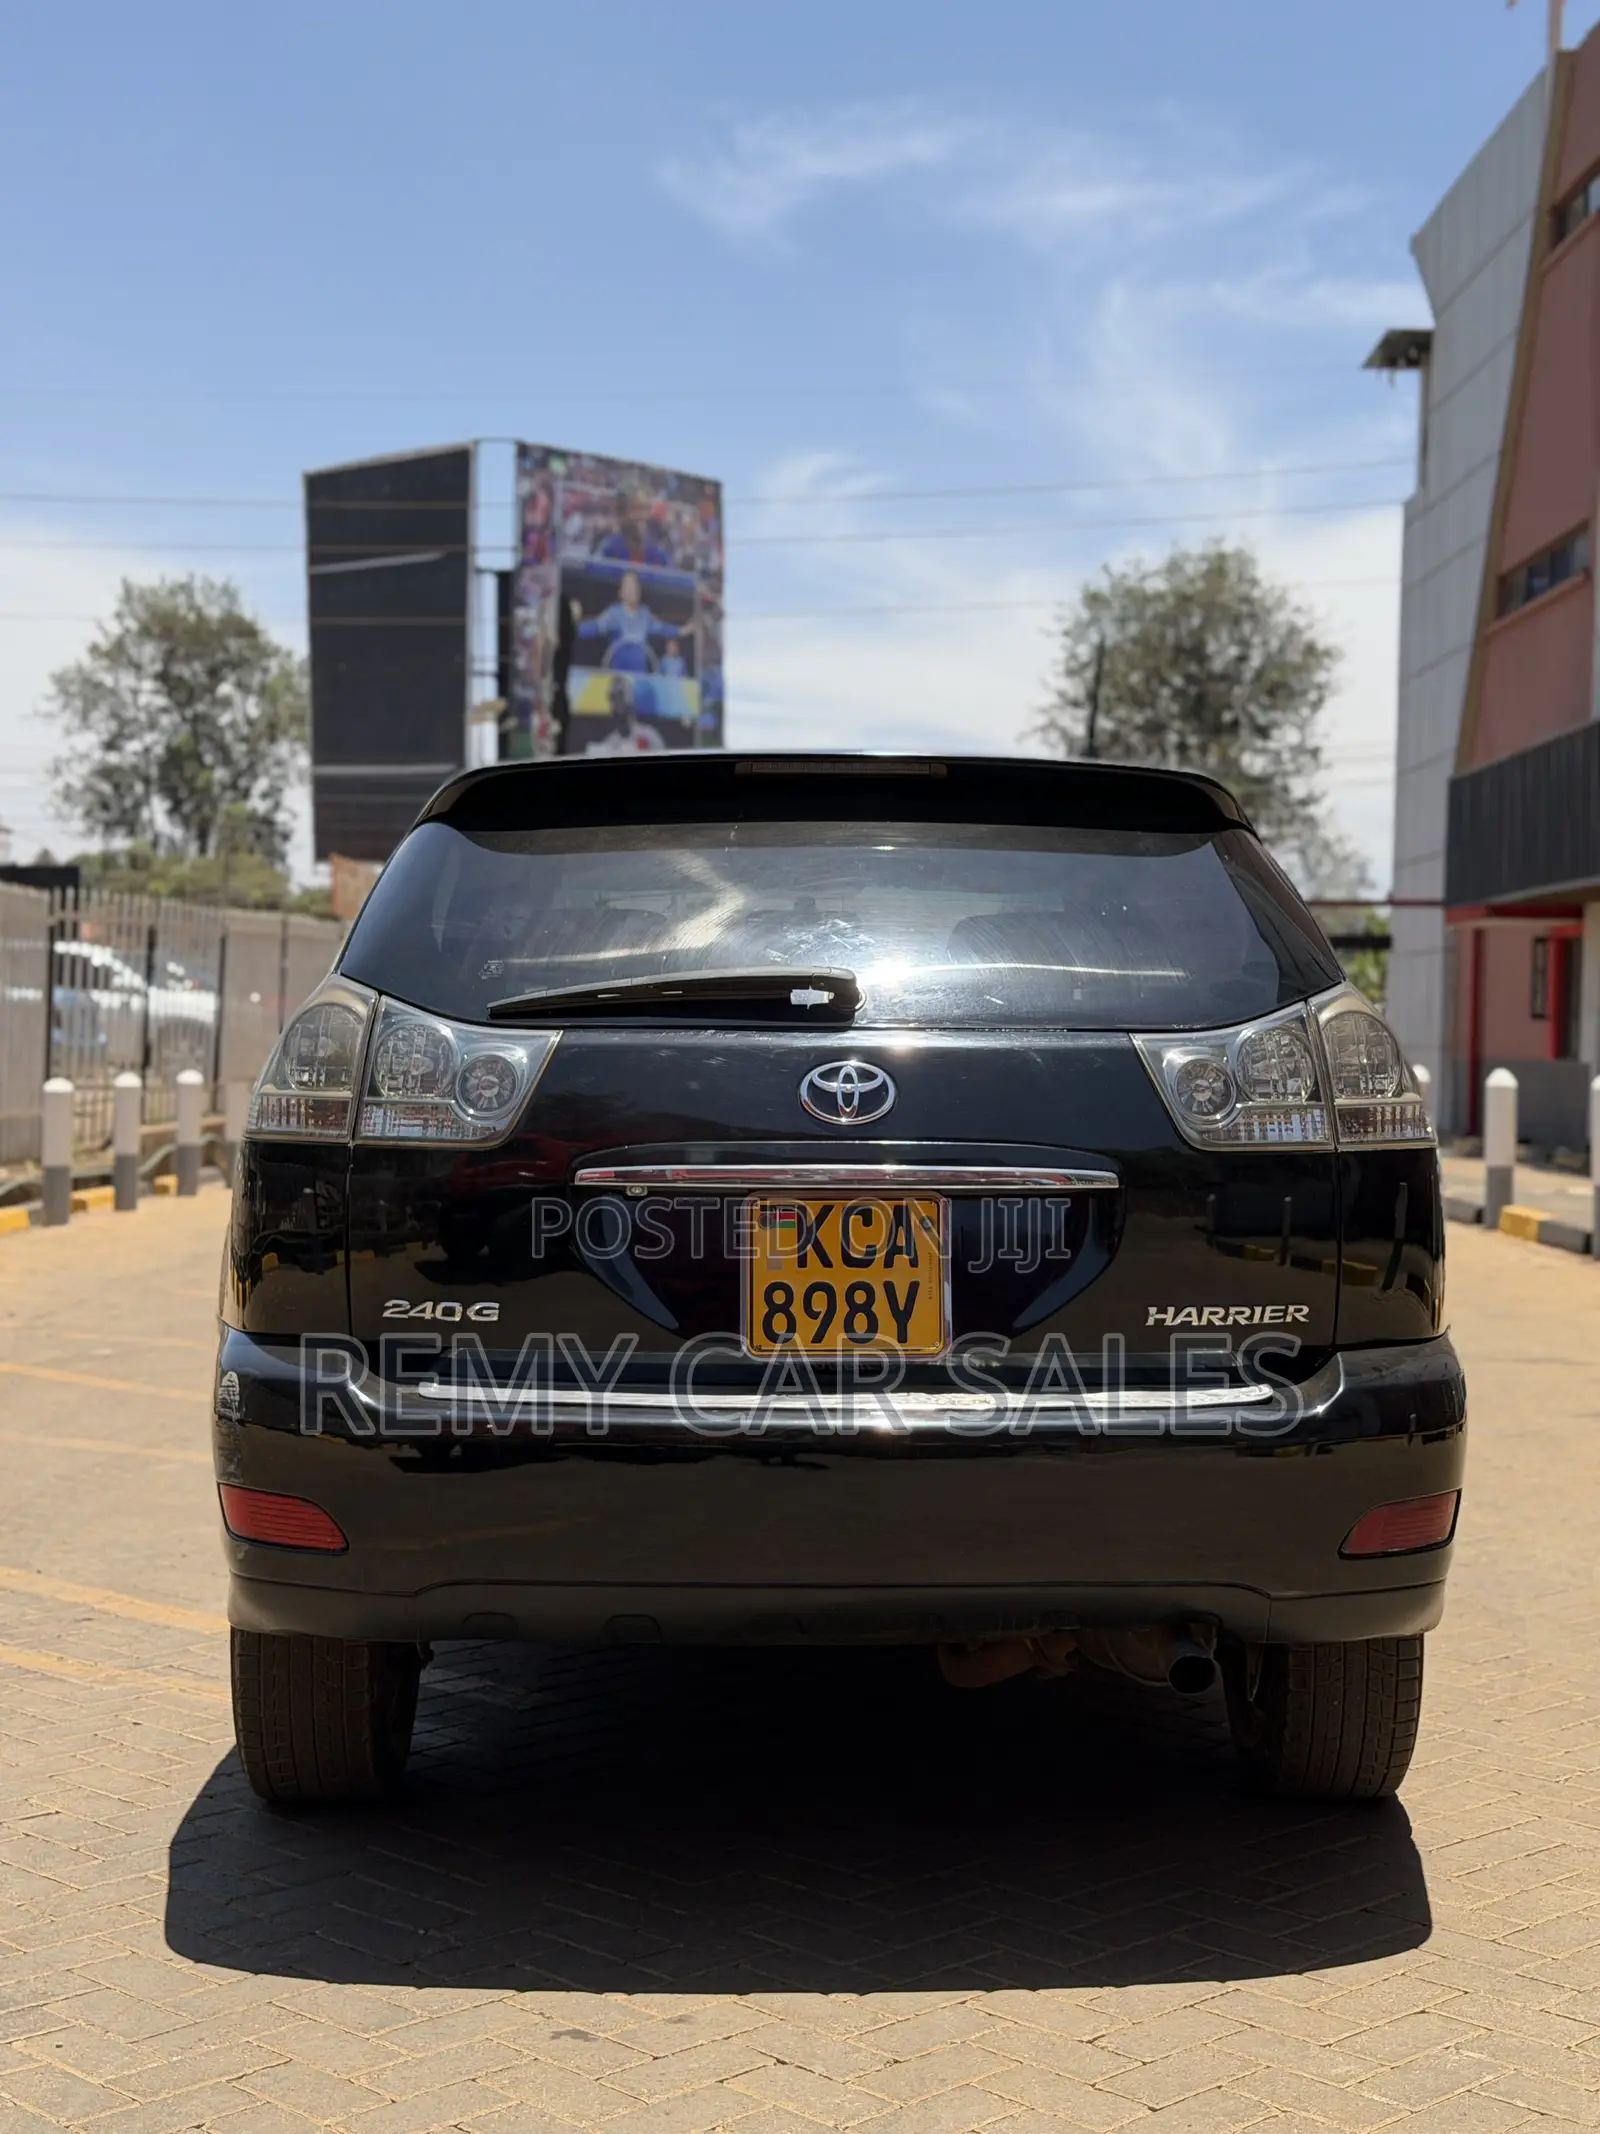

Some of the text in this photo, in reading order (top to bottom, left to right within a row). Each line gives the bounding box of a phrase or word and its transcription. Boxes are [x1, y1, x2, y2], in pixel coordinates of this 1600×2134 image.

[797, 1204, 919, 1268] KCA
[382, 1299, 500, 1321] 240G
[762, 1280, 921, 1344] 898Y
[1145, 1304, 1310, 1326] HARRIER
